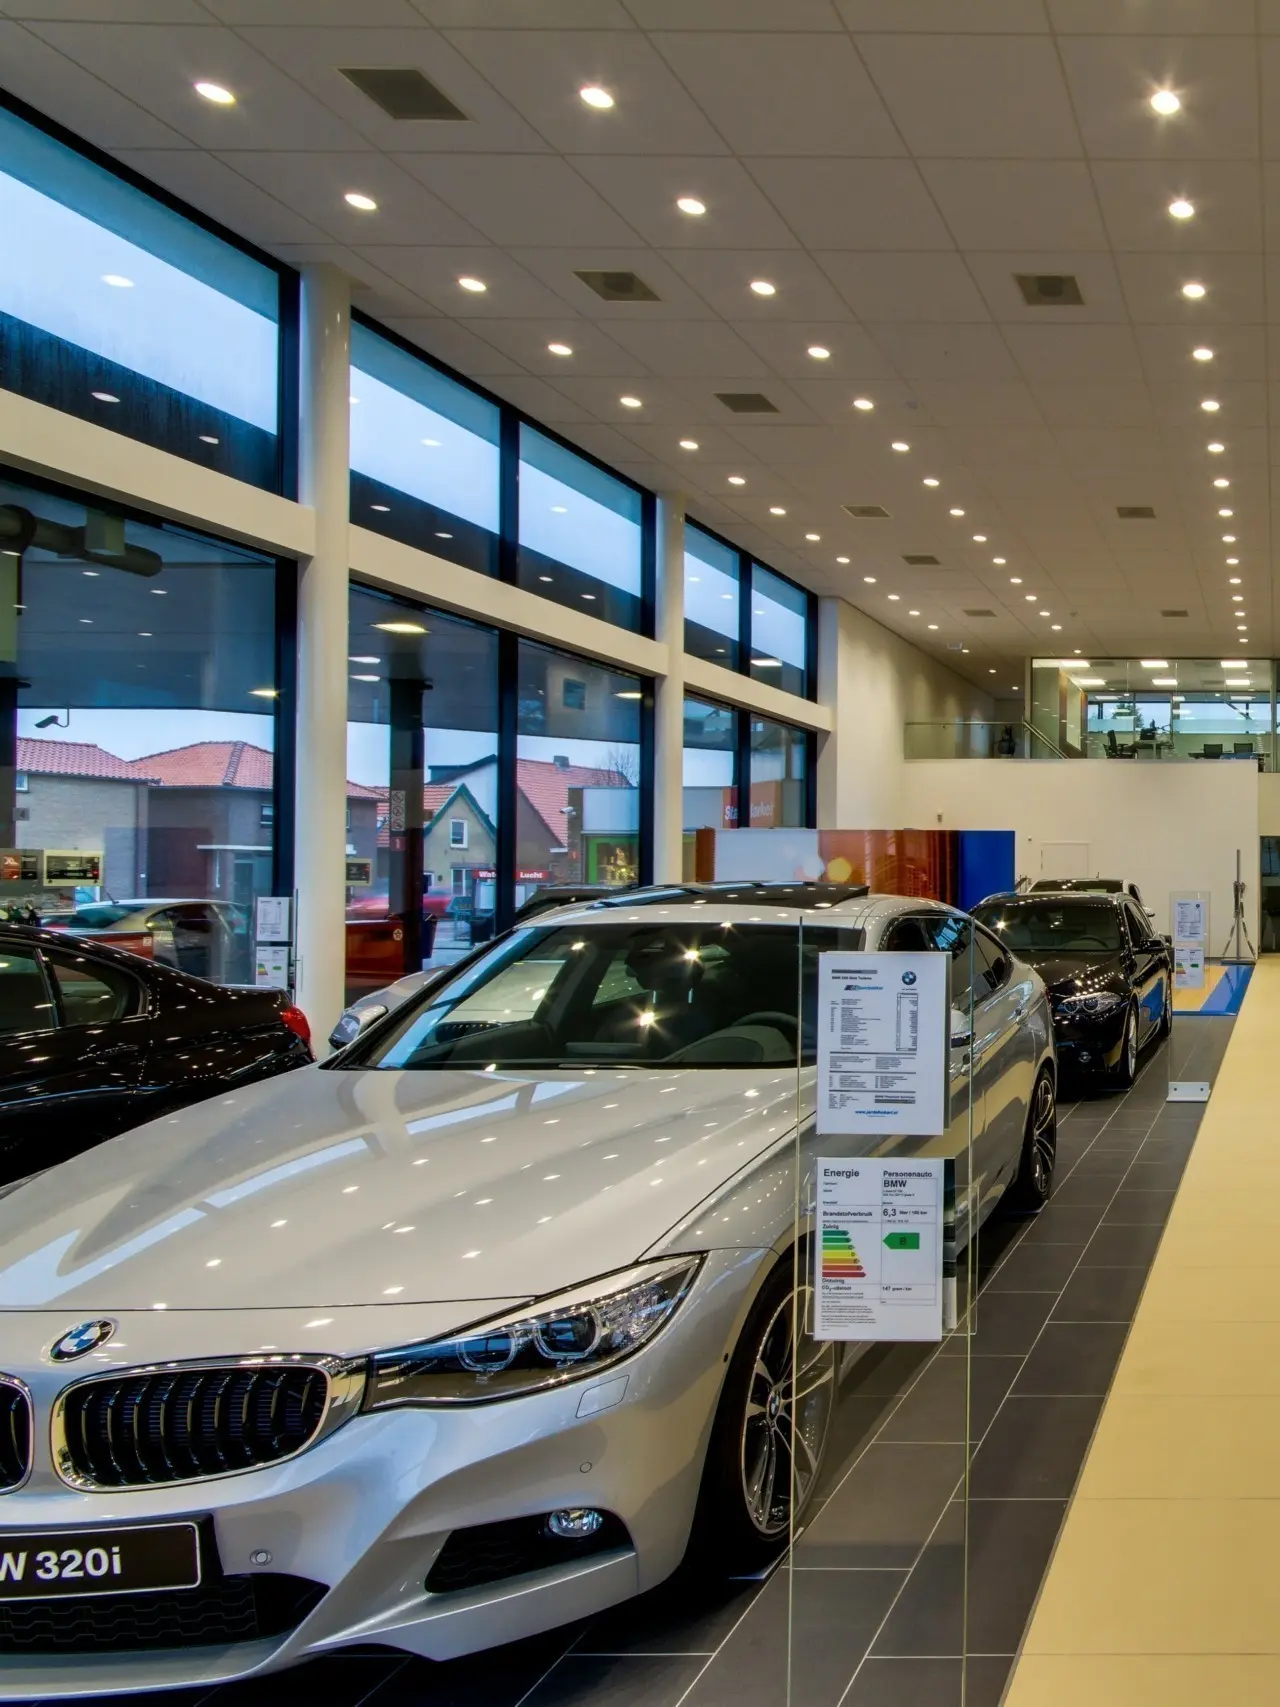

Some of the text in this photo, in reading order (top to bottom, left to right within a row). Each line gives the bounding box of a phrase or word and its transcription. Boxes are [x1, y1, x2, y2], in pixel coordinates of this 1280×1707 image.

[520, 871, 543, 879] Lucht
[824, 1168, 860, 1179] Energie
[883, 1170, 932, 1178] Personenauto
[884, 1180, 907, 1188] BMW
[883, 1208, 896, 1217] 6,3
[36, 1546, 121, 1580] 320i
